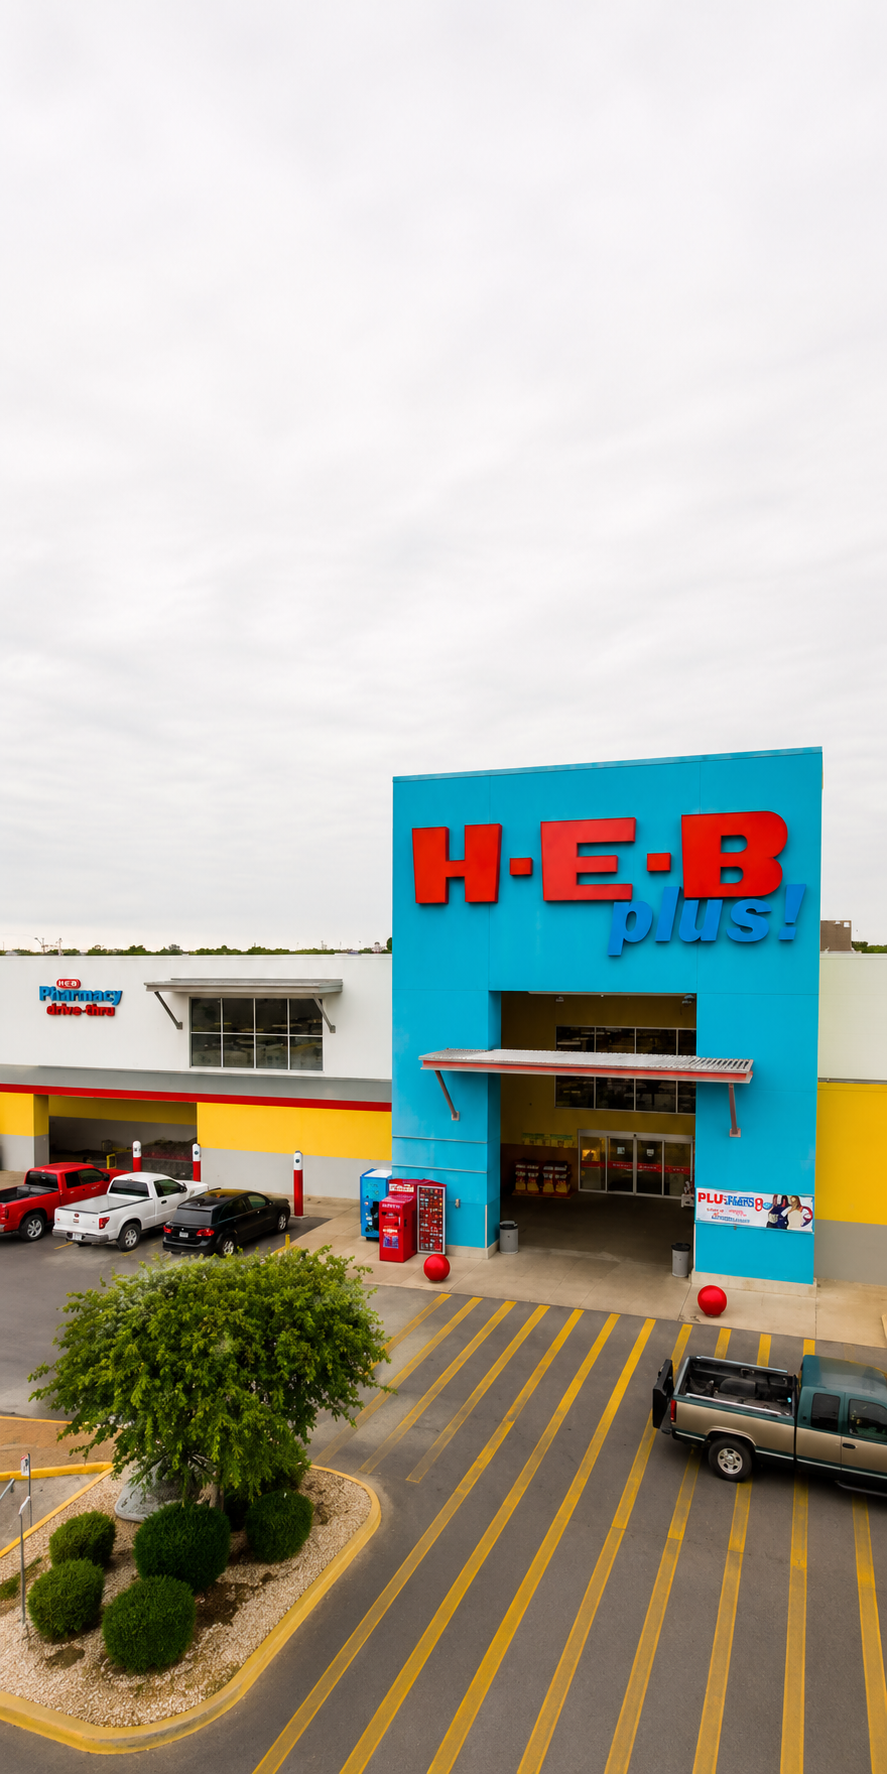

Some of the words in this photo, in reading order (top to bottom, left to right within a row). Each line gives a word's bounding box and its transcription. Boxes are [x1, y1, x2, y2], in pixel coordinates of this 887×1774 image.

[608, 884, 806, 956] plus!
[39, 986, 123, 1006] Pharmacy
[46, 1003, 115, 1017] drive-thru
